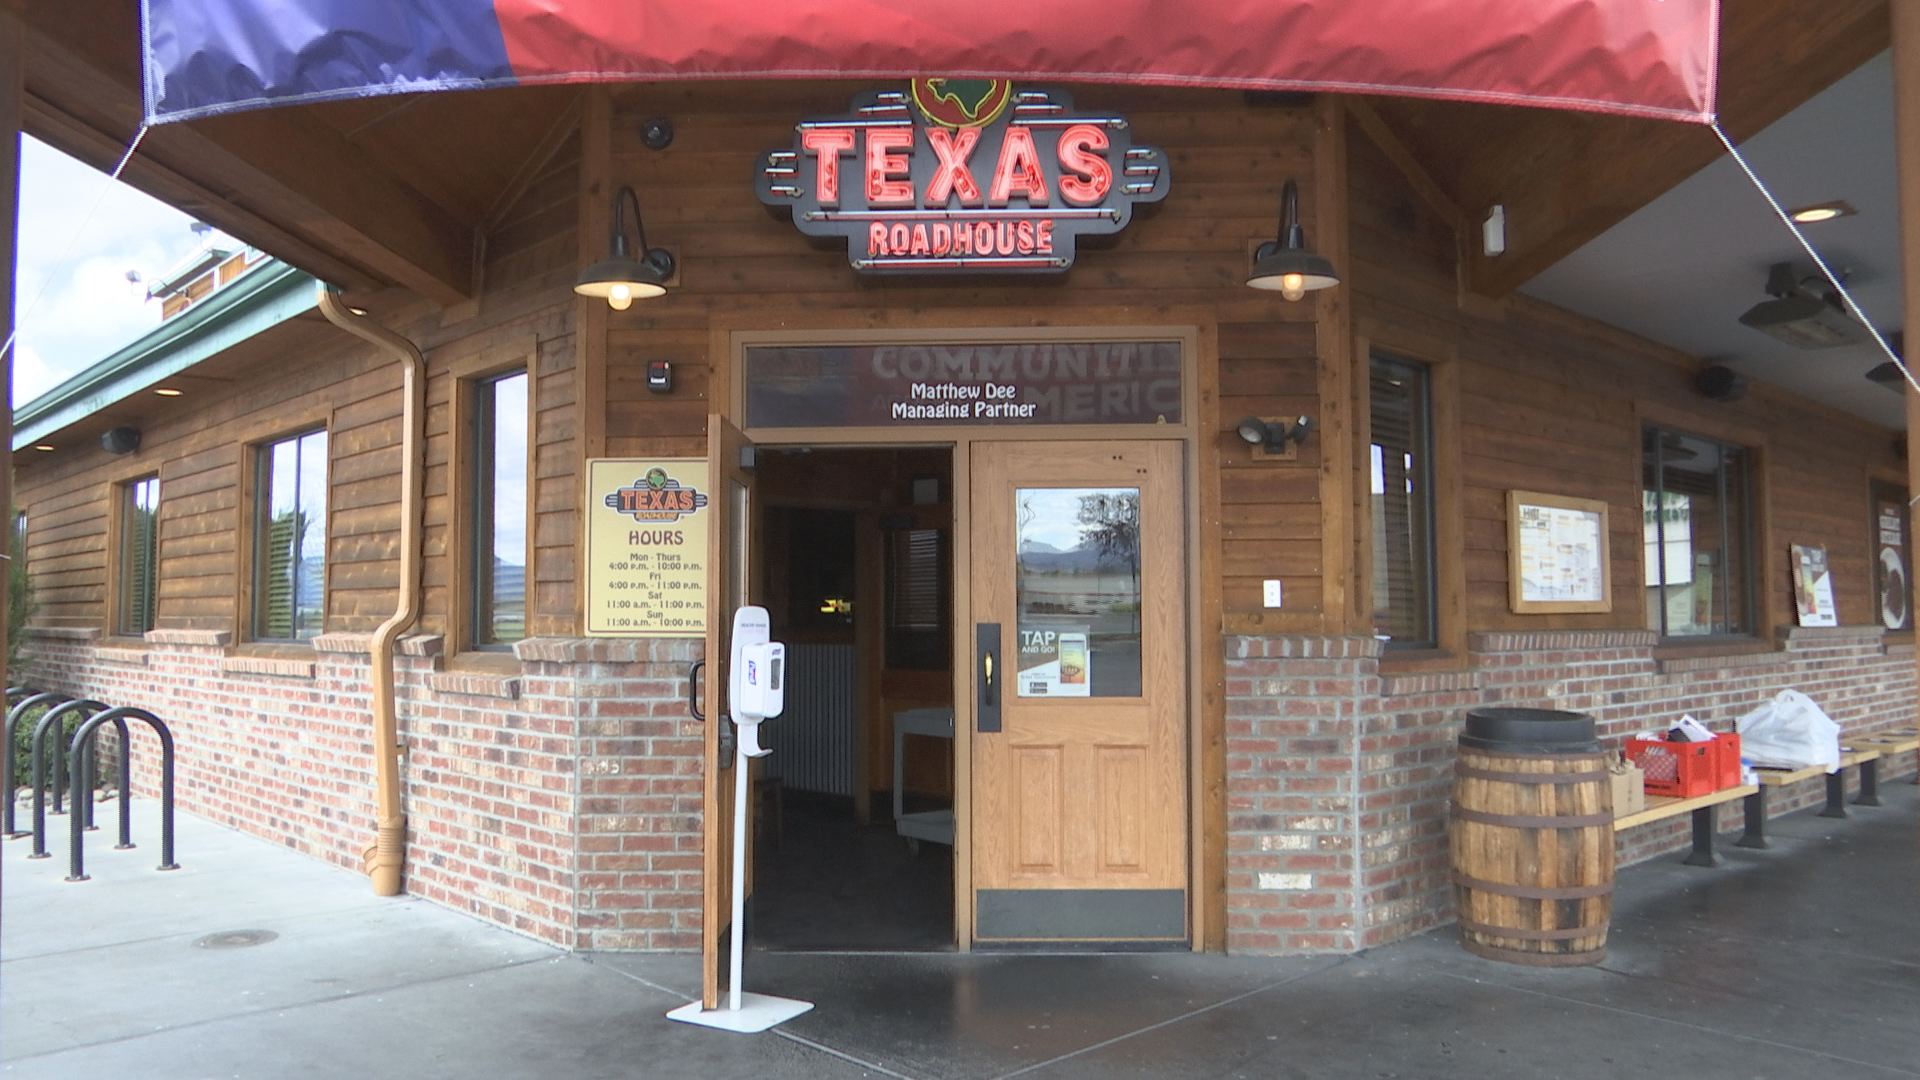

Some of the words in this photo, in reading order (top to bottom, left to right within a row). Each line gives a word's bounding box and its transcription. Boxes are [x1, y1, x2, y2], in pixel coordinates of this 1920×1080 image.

[801, 125, 1113, 208] TEXAS
[868, 219, 1054, 257] ROADHOUSE
[911, 382, 981, 400] Matthew
[985, 382, 1016, 399] Dee
[1023, 379, 1178, 421] MERIC
[892, 402, 969, 419] Managing
[975, 402, 1037, 418] Partner
[620, 490, 694, 510] TEXAS
[629, 530, 684, 545] HOURS
[630, 553, 649, 561] Mon
[656, 553, 681, 561] Thurs
[609, 562, 628, 570] 4:00
[657, 562, 681, 570] 10:00
[649, 572, 661, 580] Fri
[609, 581, 628, 589] 4:00
[657, 581, 681, 589] 11:00
[648, 592, 662, 600] Sat
[607, 600, 630, 608] 11:00
[660, 600, 683, 608] 11:00
[646, 611, 663, 619] Sun
[607, 619, 630, 627] 11:00
[660, 619, 683, 627] 10:00
[1021, 631, 1055, 645] TAP
